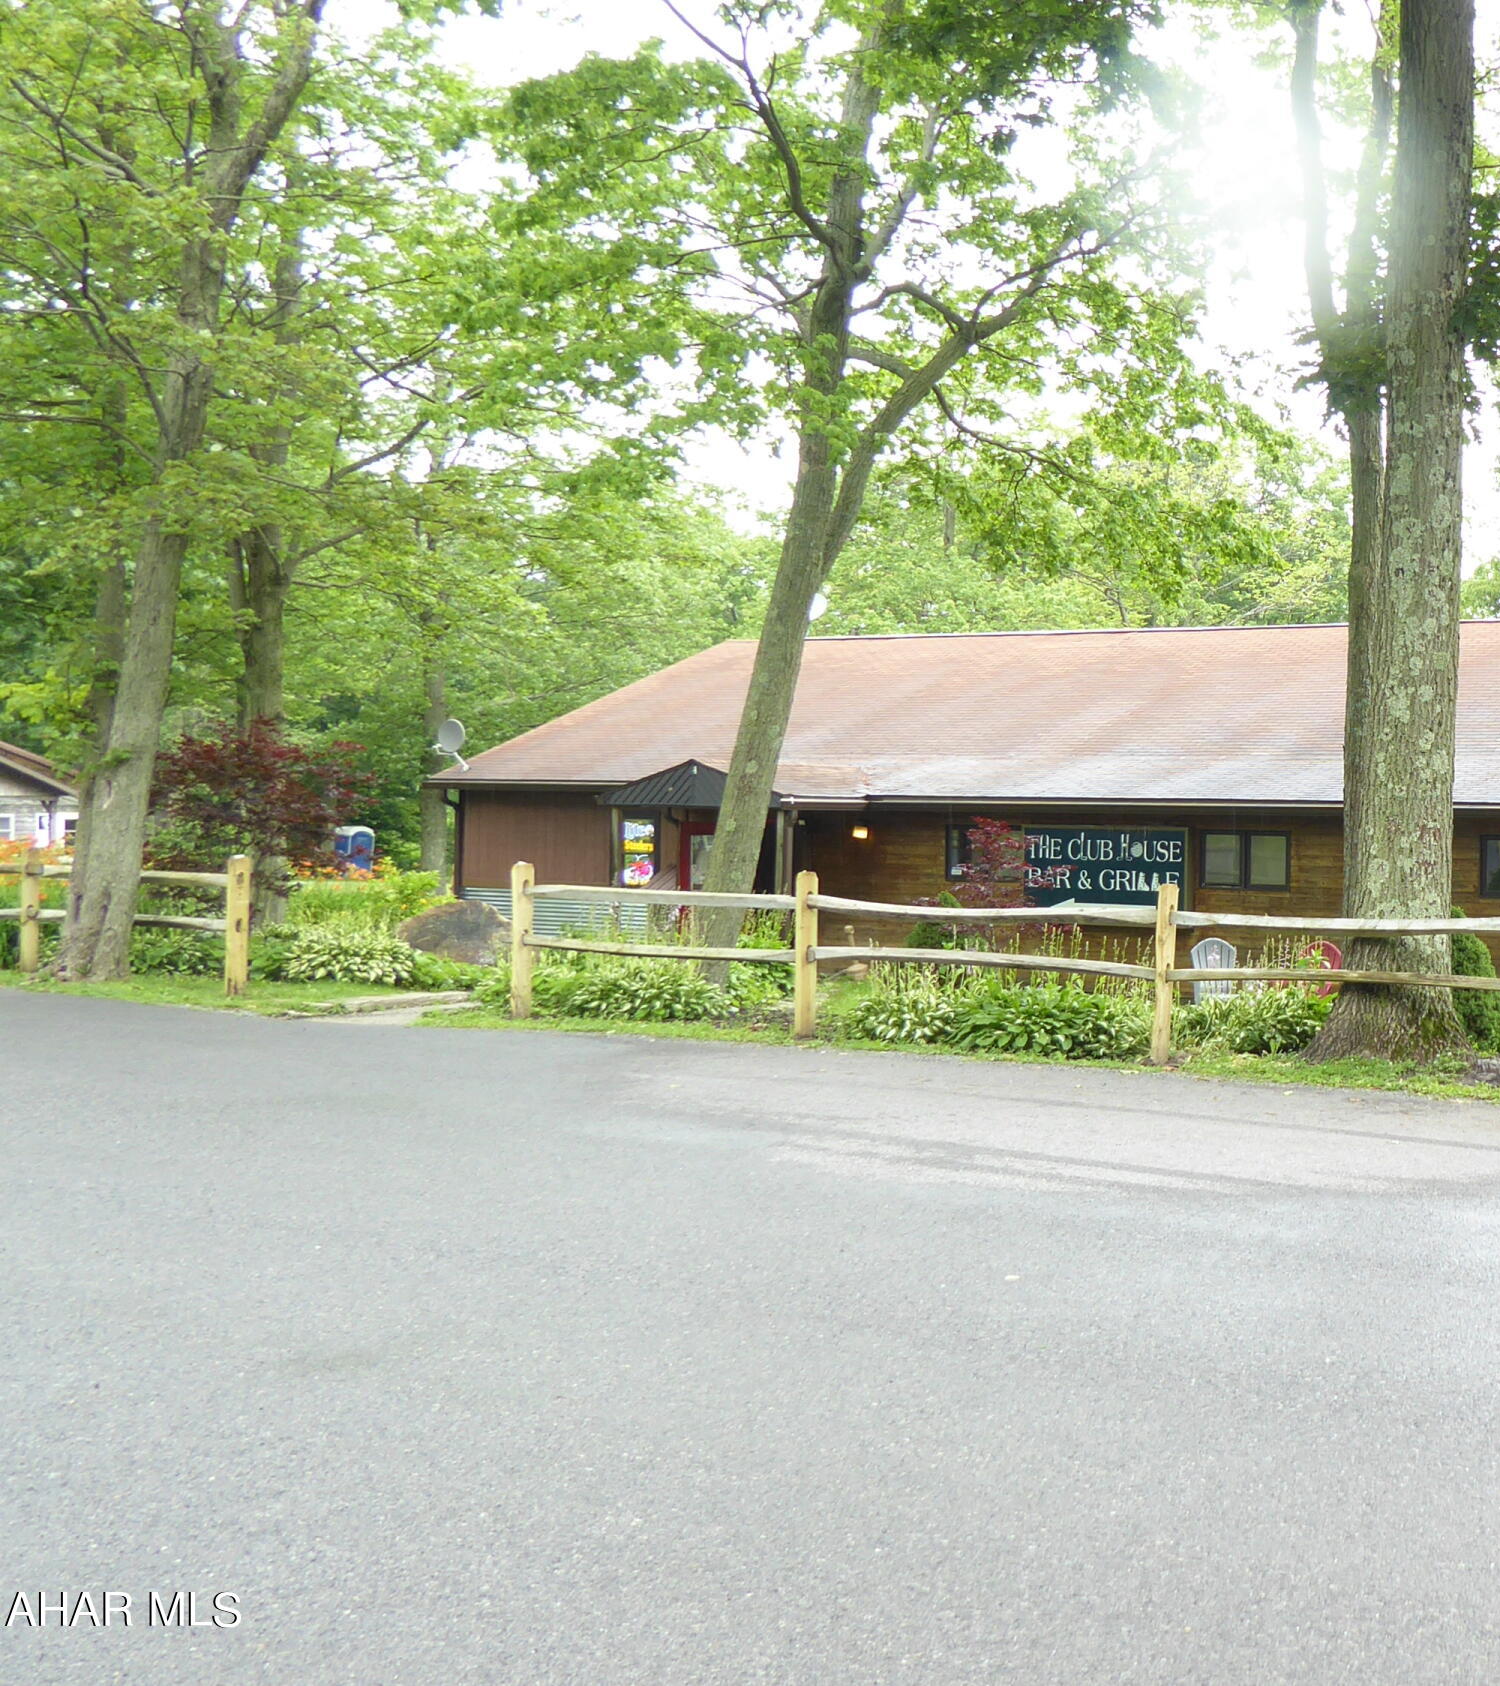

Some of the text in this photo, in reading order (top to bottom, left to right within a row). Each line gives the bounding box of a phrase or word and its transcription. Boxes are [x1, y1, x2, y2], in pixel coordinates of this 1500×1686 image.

[1025, 832, 1182, 863] THE CLUB HOUSE
[1027, 866, 1071, 889] BAR
[1077, 869, 1092, 890] &
